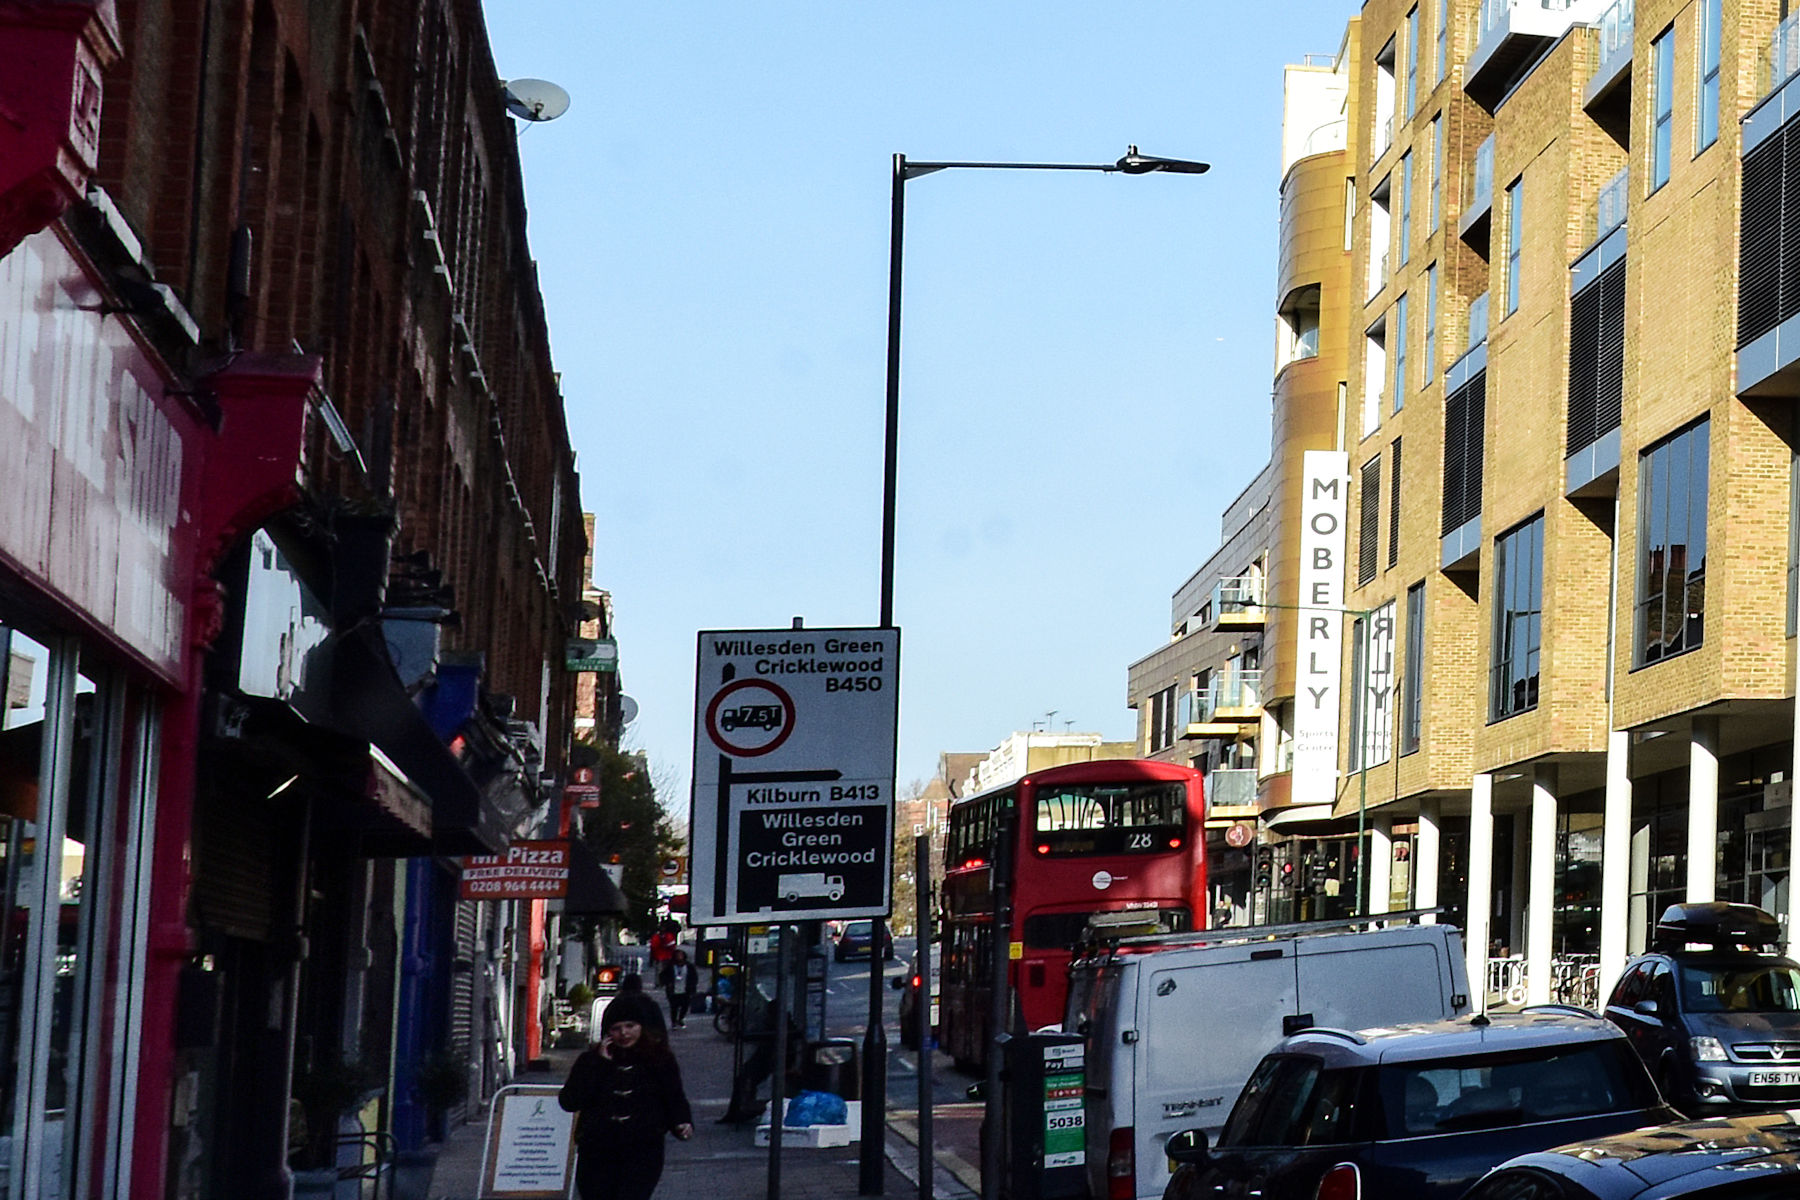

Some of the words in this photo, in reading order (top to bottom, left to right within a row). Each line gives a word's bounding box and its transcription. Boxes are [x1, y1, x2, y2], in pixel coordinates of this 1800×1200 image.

[115, 369, 182, 556] SHOP
[1307, 478, 1339, 710] MOBERLY
[714, 640, 815, 656] Willesden
[824, 638, 884, 654] Green
[755, 658, 883, 675] Cricklewood
[826, 676, 882, 693] B450
[747, 788, 821, 804] Kilburn
[830, 785, 880, 801] B413
[762, 813, 863, 829] Willesden
[782, 832, 842, 847] Green
[1130, 833, 1152, 849] 28
[507, 847, 563, 864] Pizza
[746, 848, 876, 867] Cricklewood
[469, 868, 499, 878] FREE
[504, 867, 564, 877] DELIVERY
[470, 881, 501, 892] 0208
[504, 881, 527, 891] 964
[529, 881, 560, 891] 4444
[1754, 1074, 1780, 1083] EN56
[1049, 1116, 1083, 1129] 5038
